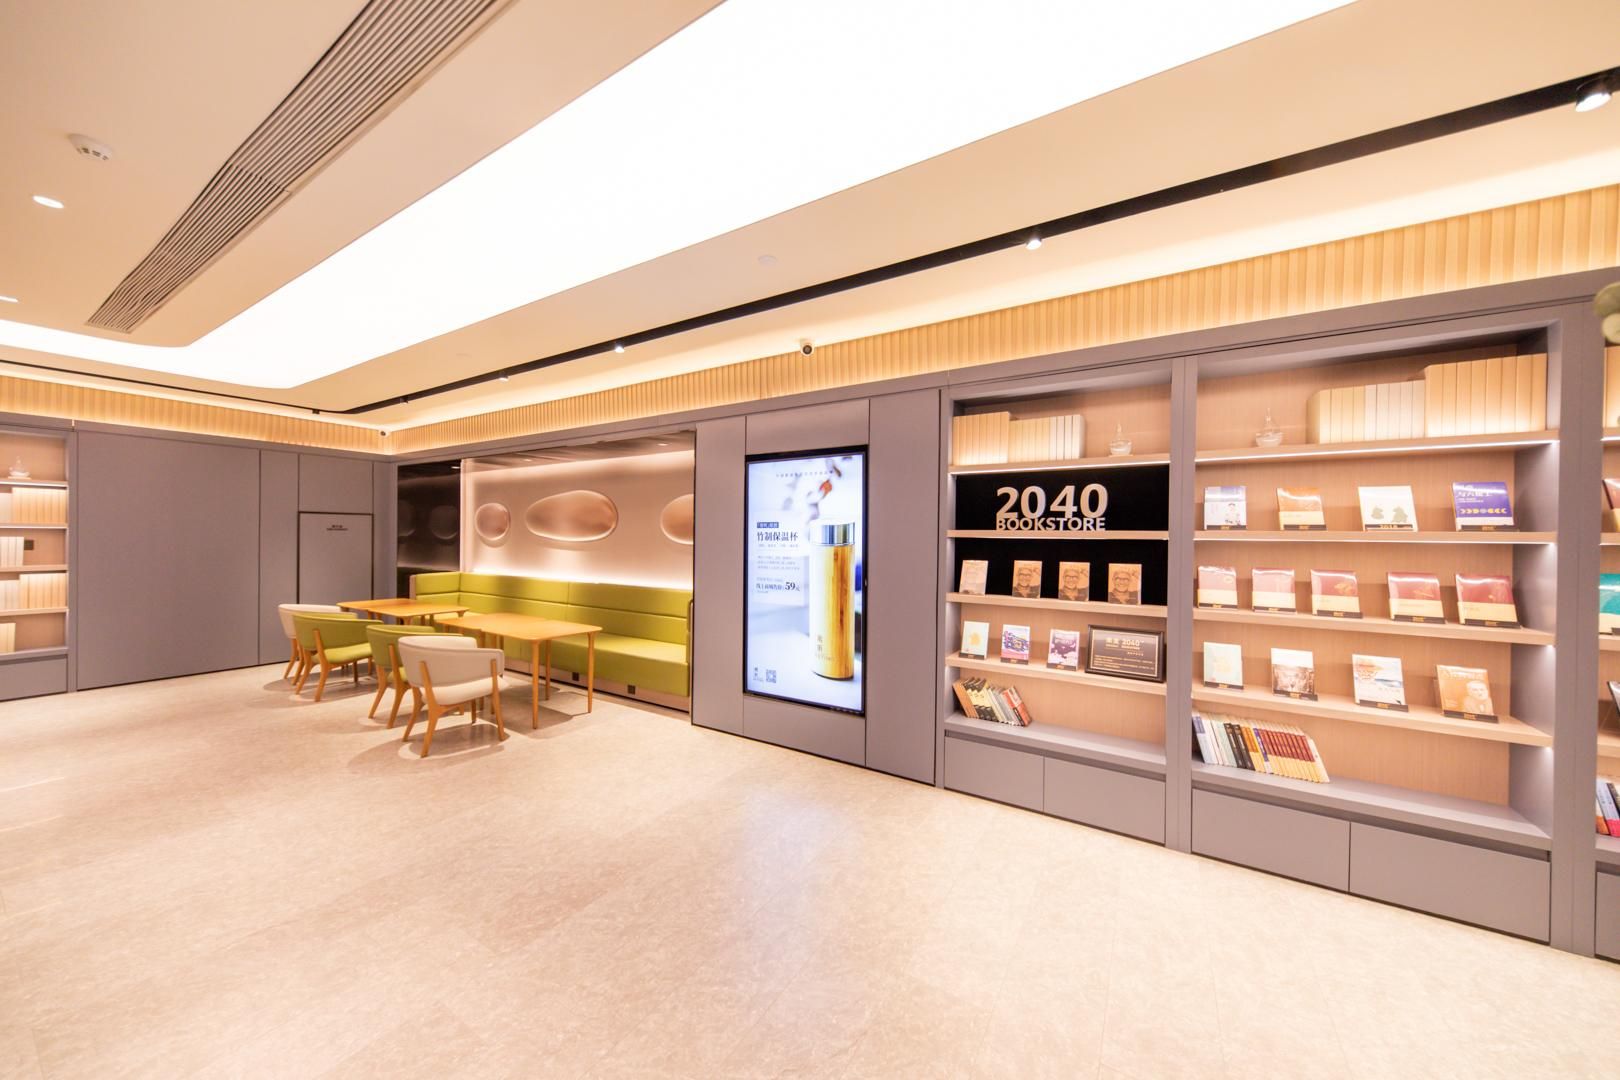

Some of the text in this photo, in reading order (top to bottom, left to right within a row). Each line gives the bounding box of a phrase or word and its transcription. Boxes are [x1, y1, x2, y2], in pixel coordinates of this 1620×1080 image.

[996, 484, 1108, 519] 2040
[996, 517, 1106, 531] BOOKSTORE
[757, 531, 798, 541] 竹制保温杯
